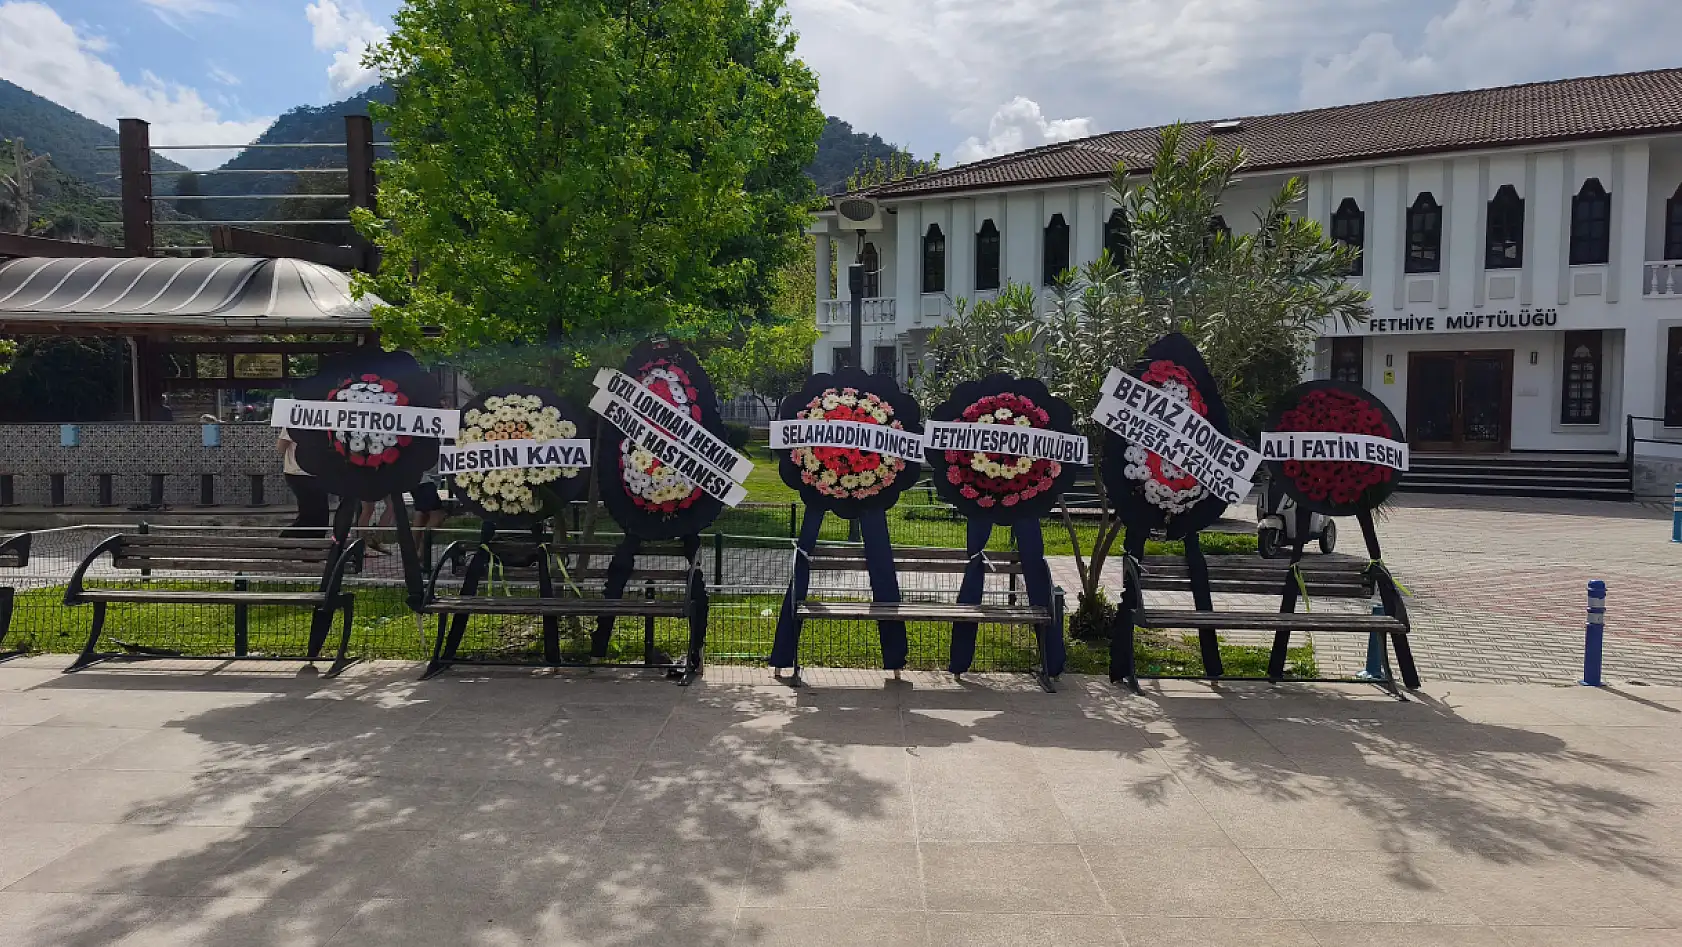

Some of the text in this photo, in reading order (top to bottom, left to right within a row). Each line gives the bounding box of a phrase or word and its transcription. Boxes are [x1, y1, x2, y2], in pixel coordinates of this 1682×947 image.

[1369, 309, 1557, 331] FETHİYE MÜFTÜLÜĞÜ
[289, 404, 445, 437] ÜNAL PETROL A.Ş.
[632, 391, 694, 440] LOKMAN
[689, 430, 738, 473] HEKİM
[1106, 412, 1177, 461] TAHSİN
[1112, 376, 1249, 472] BEYAZ HOMES
[440, 444, 588, 473] NESRİN KAYA
[604, 400, 733, 500] ESNAF HASTANESİ
[782, 423, 922, 459] SELAHADDİN DİNÇEL
[931, 425, 1085, 462] FETHİYESPOR KULÜBÜ
[1117, 407, 1234, 489] ÖMER KIZILCA
[1263, 434, 1403, 468] ALİ FATİN ESEN
